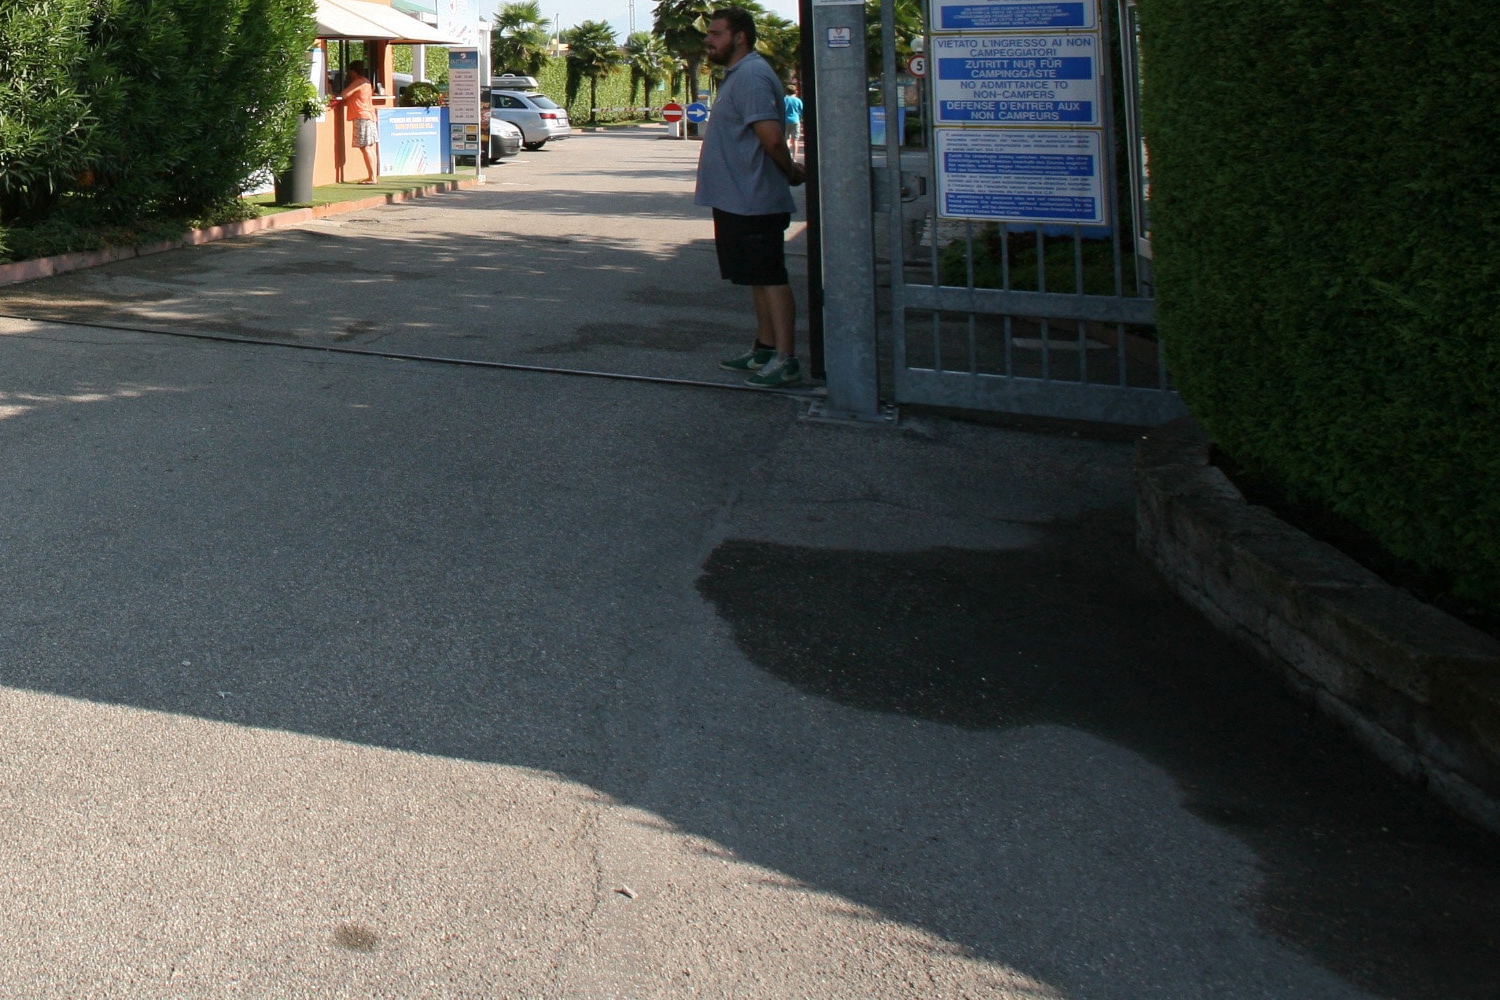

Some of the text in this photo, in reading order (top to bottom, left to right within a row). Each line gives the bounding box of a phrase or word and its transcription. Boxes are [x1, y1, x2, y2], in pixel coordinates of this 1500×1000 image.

[937, 40, 978, 48] VIETATO
[982, 38, 1047, 48] L'INGRESSO
[1066, 37, 1091, 46] NON
[969, 48, 1057, 57] CAMPEGGIATORI
[916, 61, 923, 71] 5
[965, 58, 1062, 69] ZUTRITT NUR FÜR
[971, 68, 1057, 78] CAMPINGGÄSTE
[960, 80, 1068, 89] NO ADMITTANCE TO
[973, 90, 1055, 99] NON-CAMPERS
[946, 101, 1081, 111] DEFENSE D'ENTRER AUX
[970, 111, 1060, 121] NON CAMPEURS
